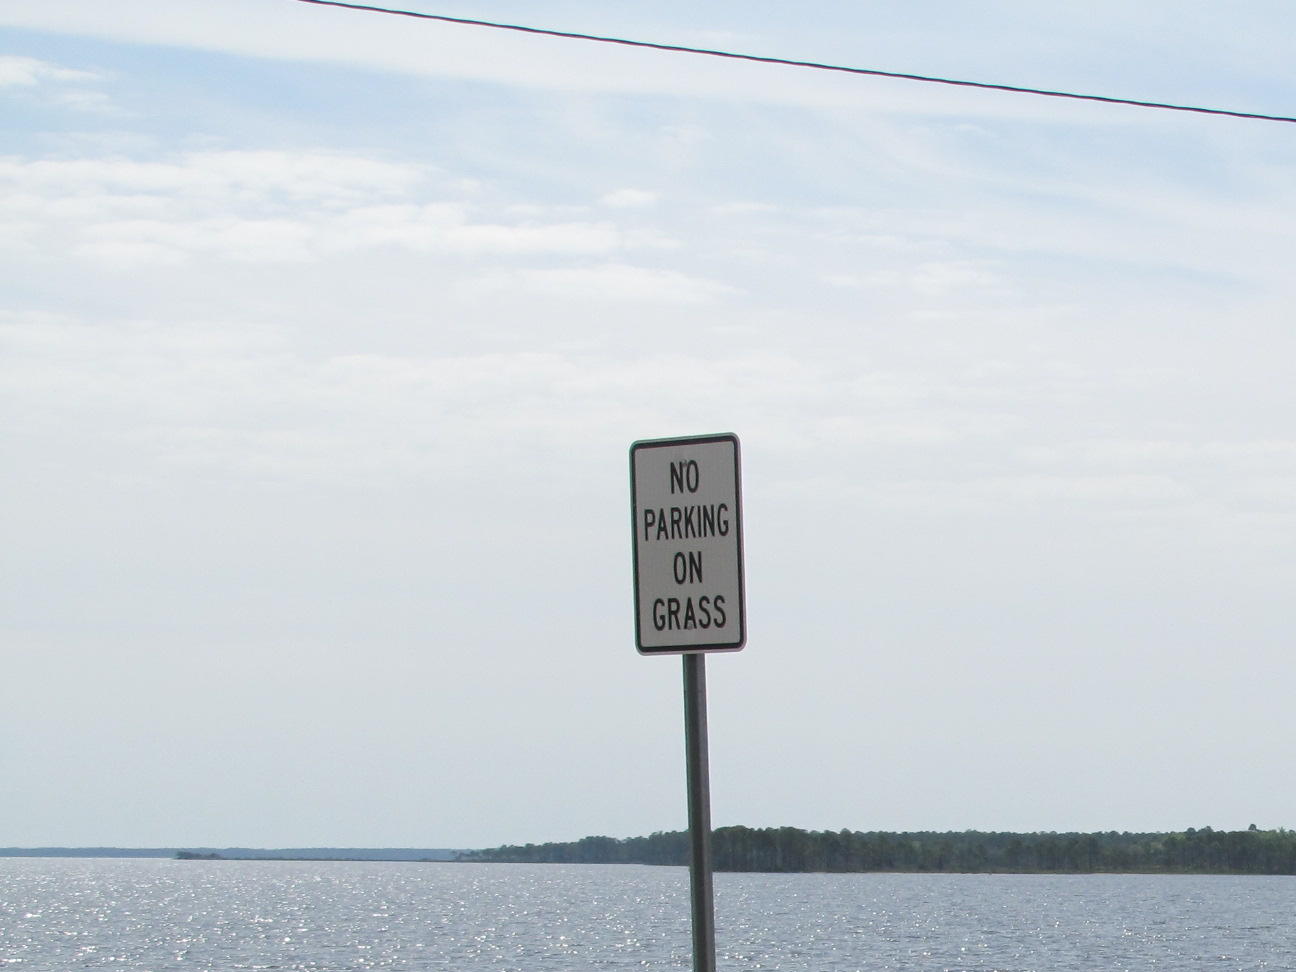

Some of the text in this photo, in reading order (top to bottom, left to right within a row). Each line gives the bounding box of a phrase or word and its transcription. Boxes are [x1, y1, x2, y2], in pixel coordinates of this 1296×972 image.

[670, 459, 699, 494] NO
[644, 503, 729, 541] PARKING
[673, 551, 703, 585] ON
[653, 595, 726, 631] GRASS
